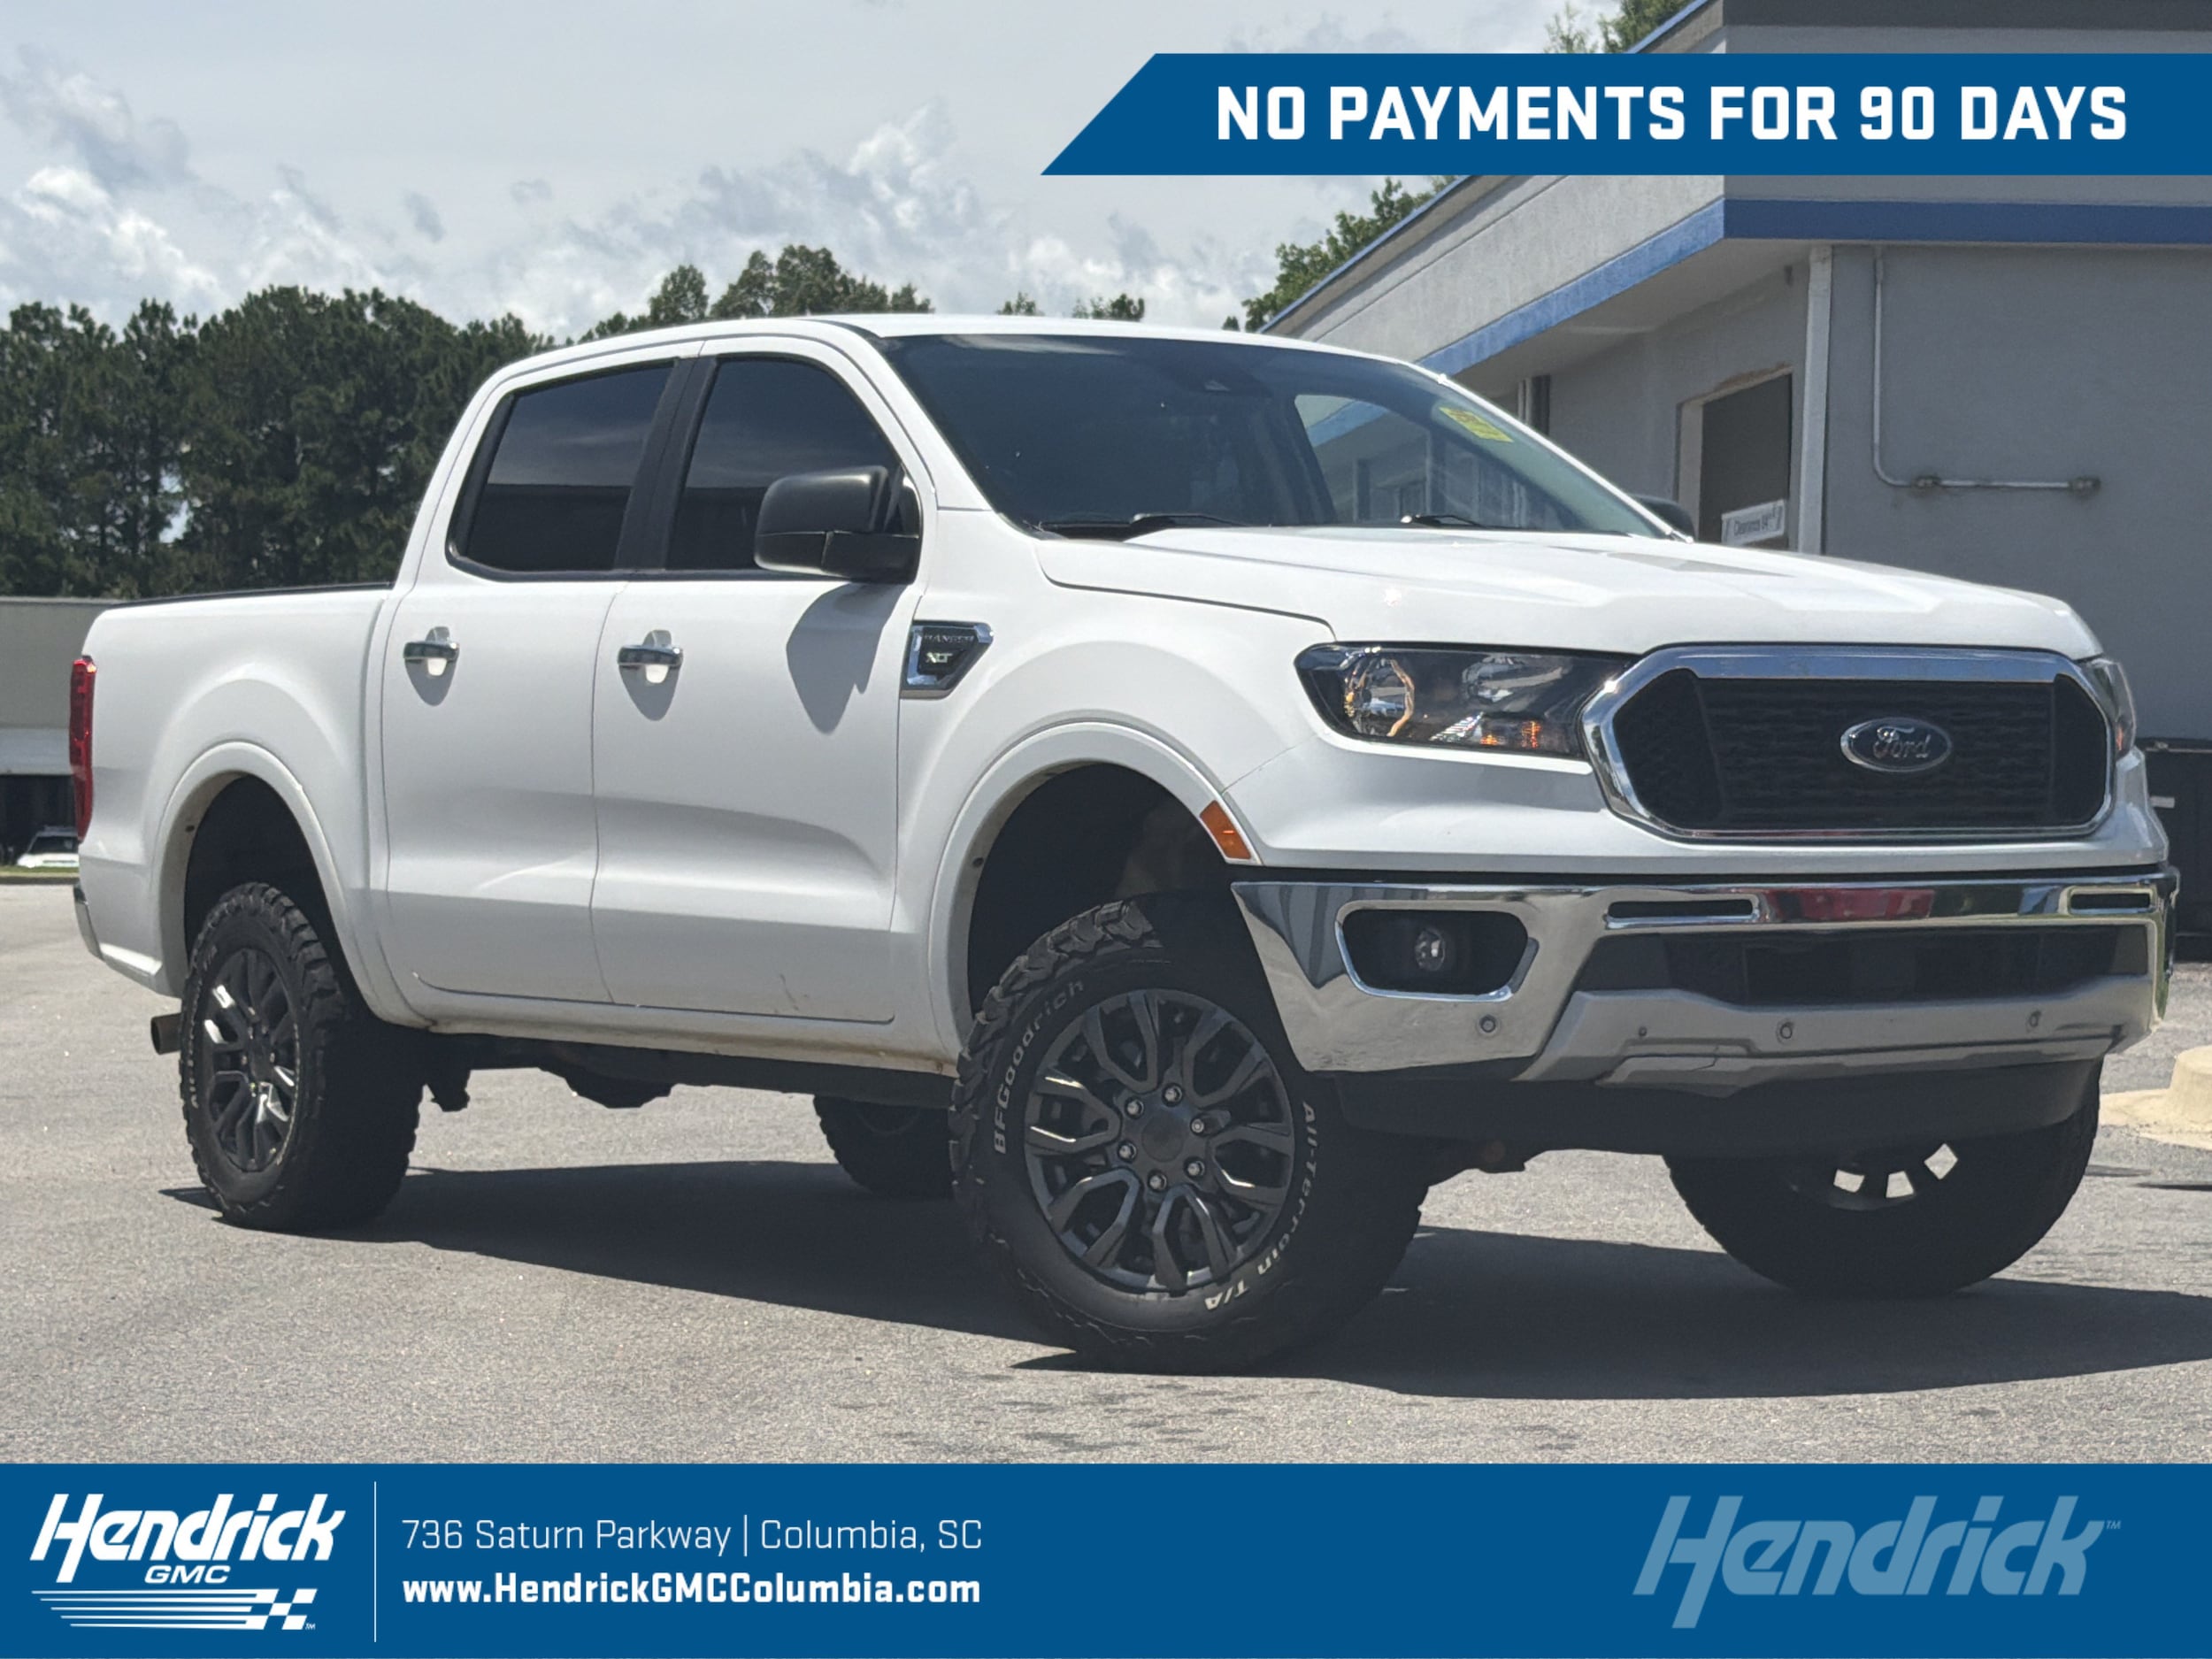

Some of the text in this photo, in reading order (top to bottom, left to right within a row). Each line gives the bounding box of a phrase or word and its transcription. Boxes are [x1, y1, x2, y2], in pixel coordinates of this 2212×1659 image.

[1872, 726, 1932, 759] Ford
[994, 980, 1084, 1155] BFGoodrich
[1204, 1280, 1250, 1310] T/A
